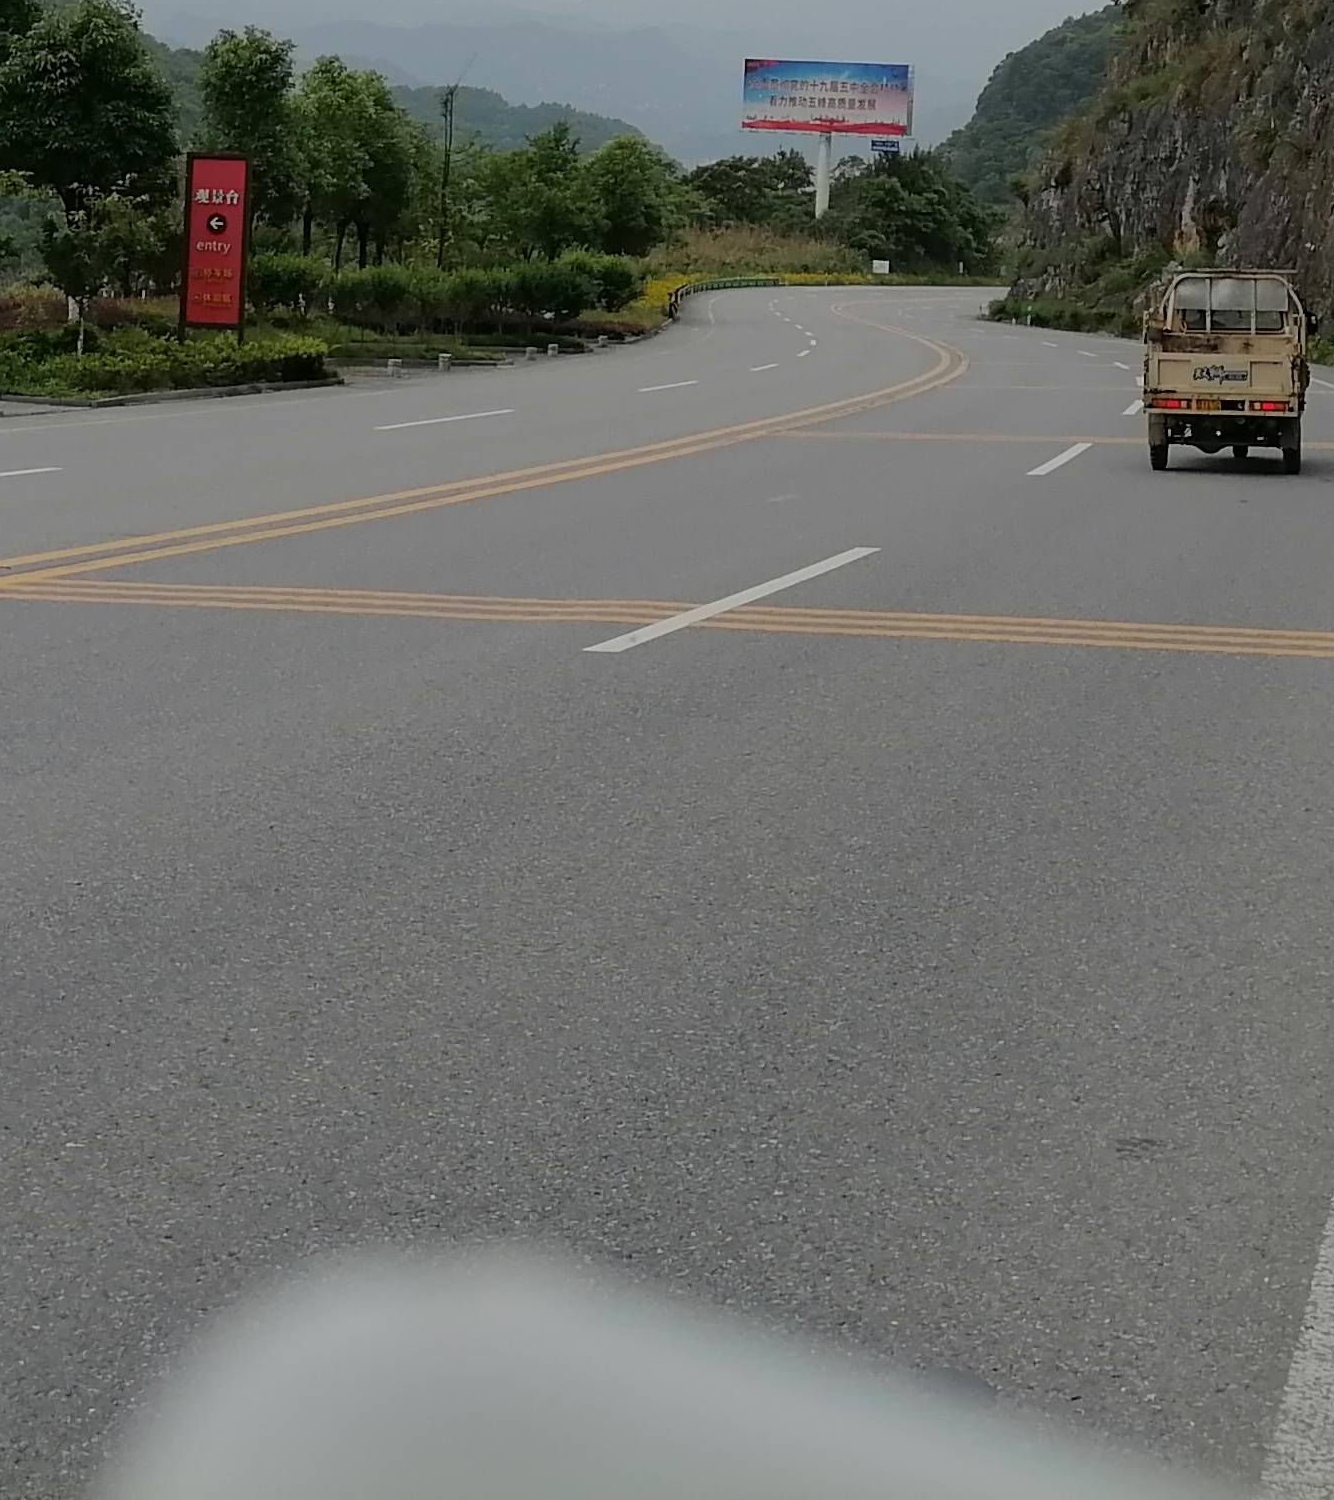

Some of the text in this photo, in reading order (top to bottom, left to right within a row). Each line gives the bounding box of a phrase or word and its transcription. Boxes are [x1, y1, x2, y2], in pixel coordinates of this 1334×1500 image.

[194, 189, 239, 204] 观景台
[196, 241, 231, 255] entry
